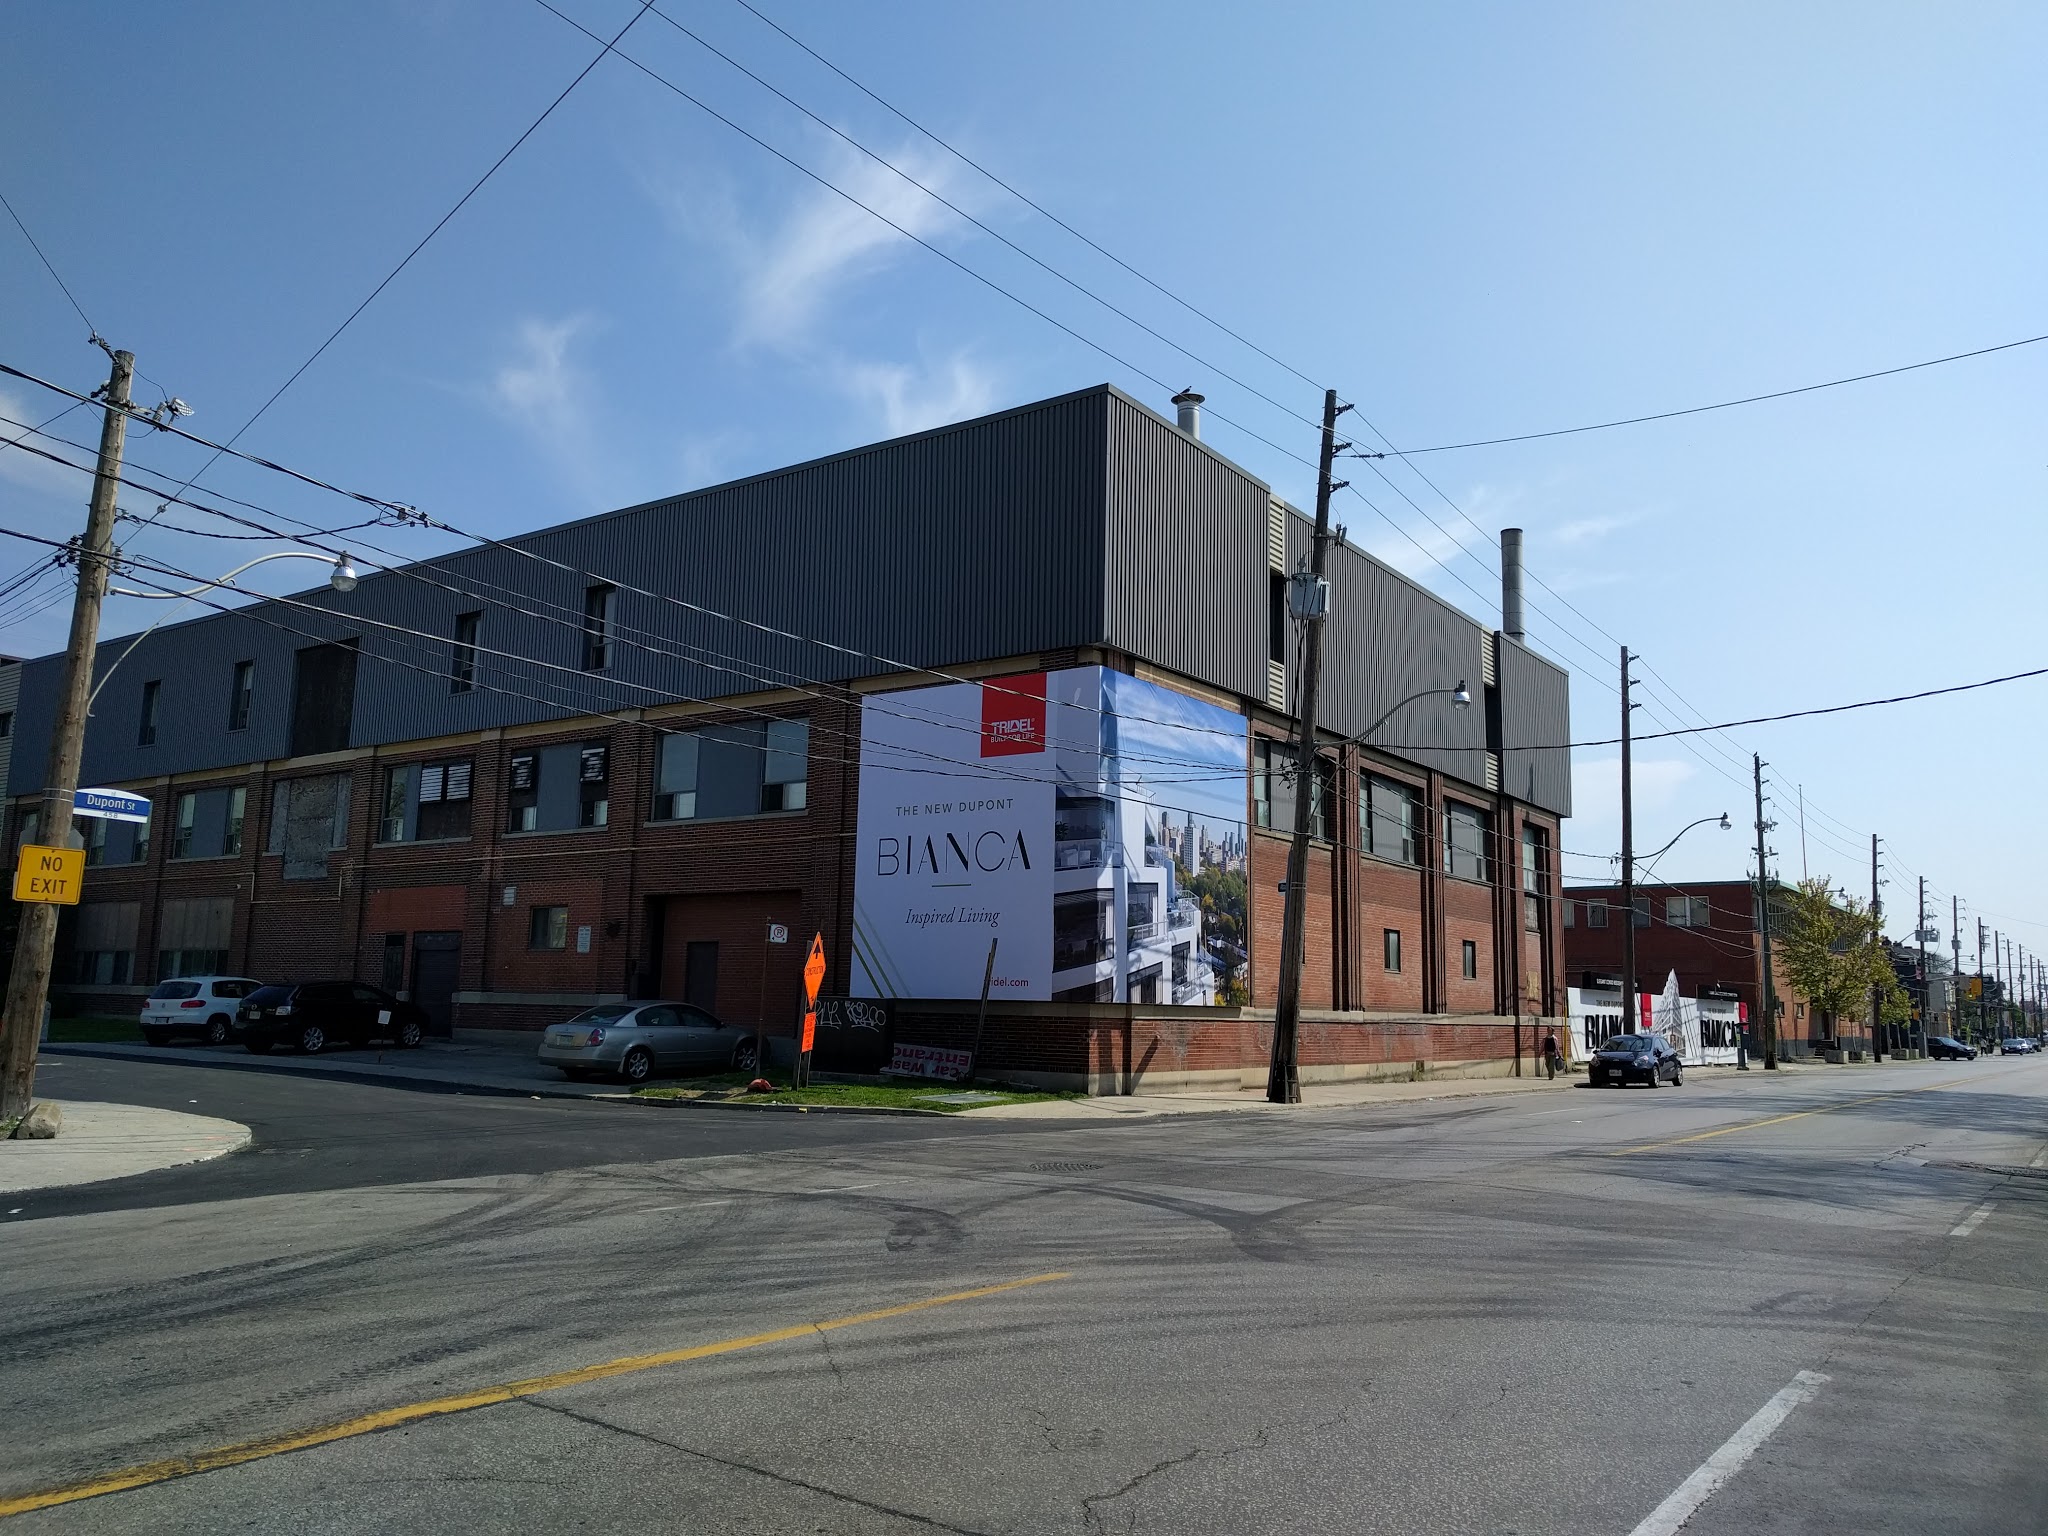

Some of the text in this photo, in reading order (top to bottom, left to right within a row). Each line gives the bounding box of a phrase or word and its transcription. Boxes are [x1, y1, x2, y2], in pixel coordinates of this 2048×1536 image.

[1022, 732, 1034, 740] LIFE
[87, 794, 135, 811] Dupont St
[895, 798, 1014, 817] THE NEW DUPONT
[877, 829, 1031, 876] BIANCA
[40, 855, 63, 872] NO
[30, 877, 68, 895] EXIT
[905, 906, 1001, 929] Inspired Living
[986, 976, 1029, 987] idel.com
[1584, 1014, 1624, 1051] BIAN
[893, 1047, 970, 1067] Entranc
